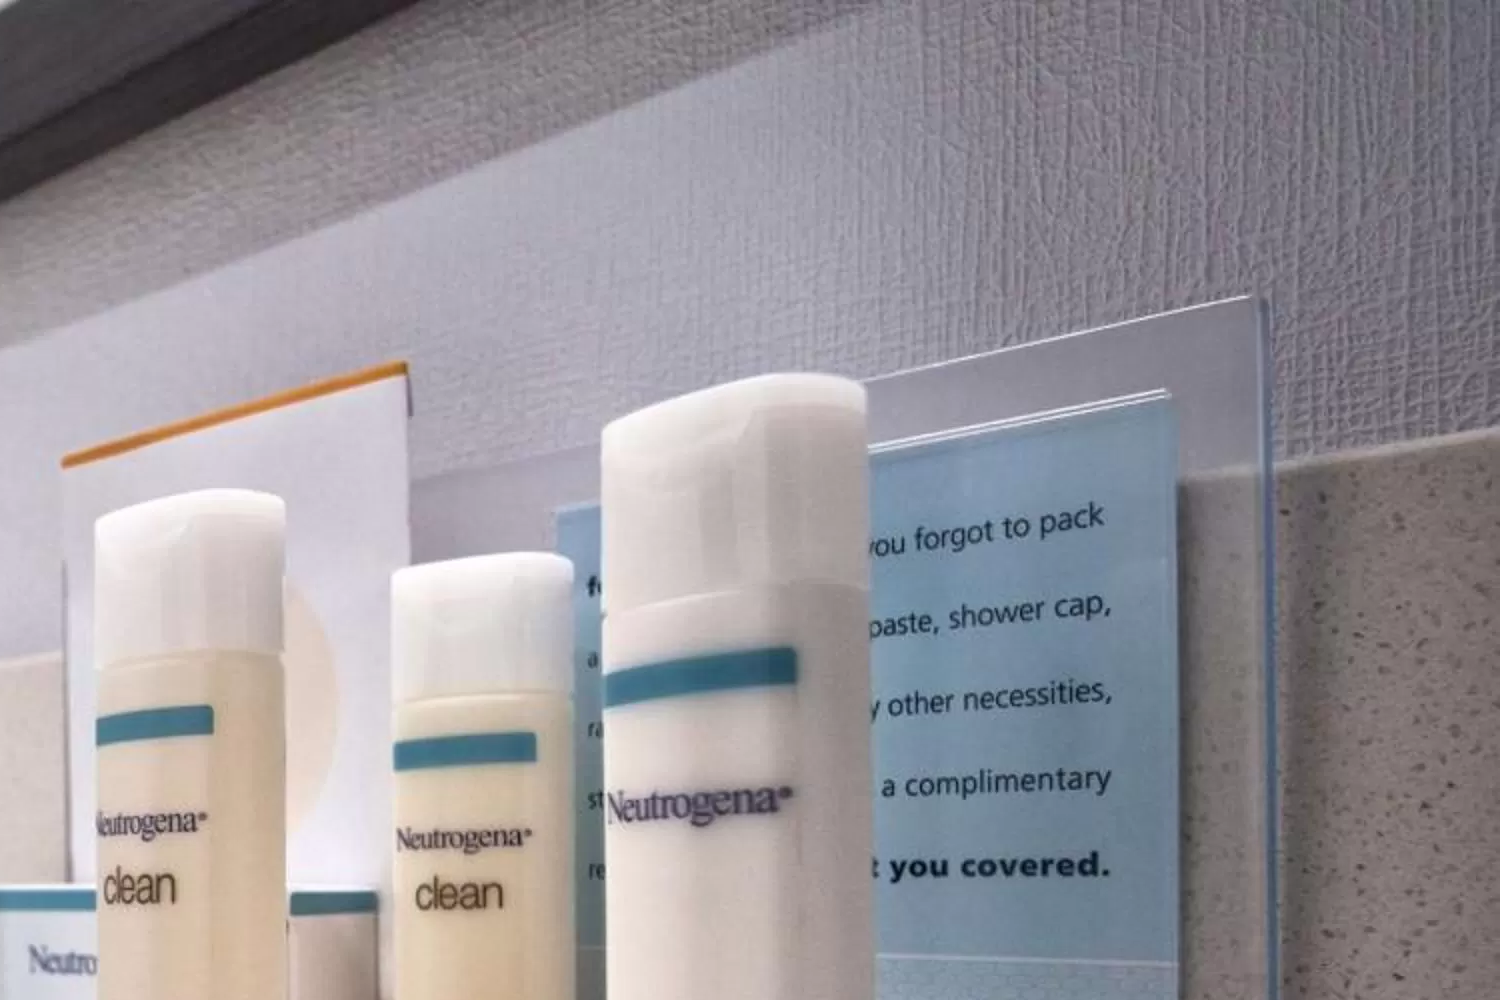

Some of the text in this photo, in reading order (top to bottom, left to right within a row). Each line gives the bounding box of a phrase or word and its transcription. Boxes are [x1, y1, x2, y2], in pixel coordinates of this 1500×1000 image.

[914, 520, 994, 552] forgot
[1001, 517, 1031, 540] to
[1040, 501, 1105, 540] pack
[949, 604, 1045, 630] shower
[1054, 595, 1111, 620] cap,
[888, 690, 954, 717] other
[963, 679, 1112, 712] necessities,
[881, 767, 1112, 800] a complimentary
[104, 864, 177, 905] clean
[889, 857, 949, 884] you
[960, 850, 1110, 878] covered.
[415, 873, 504, 911] clean
[27, 943, 98, 976] Neutro
